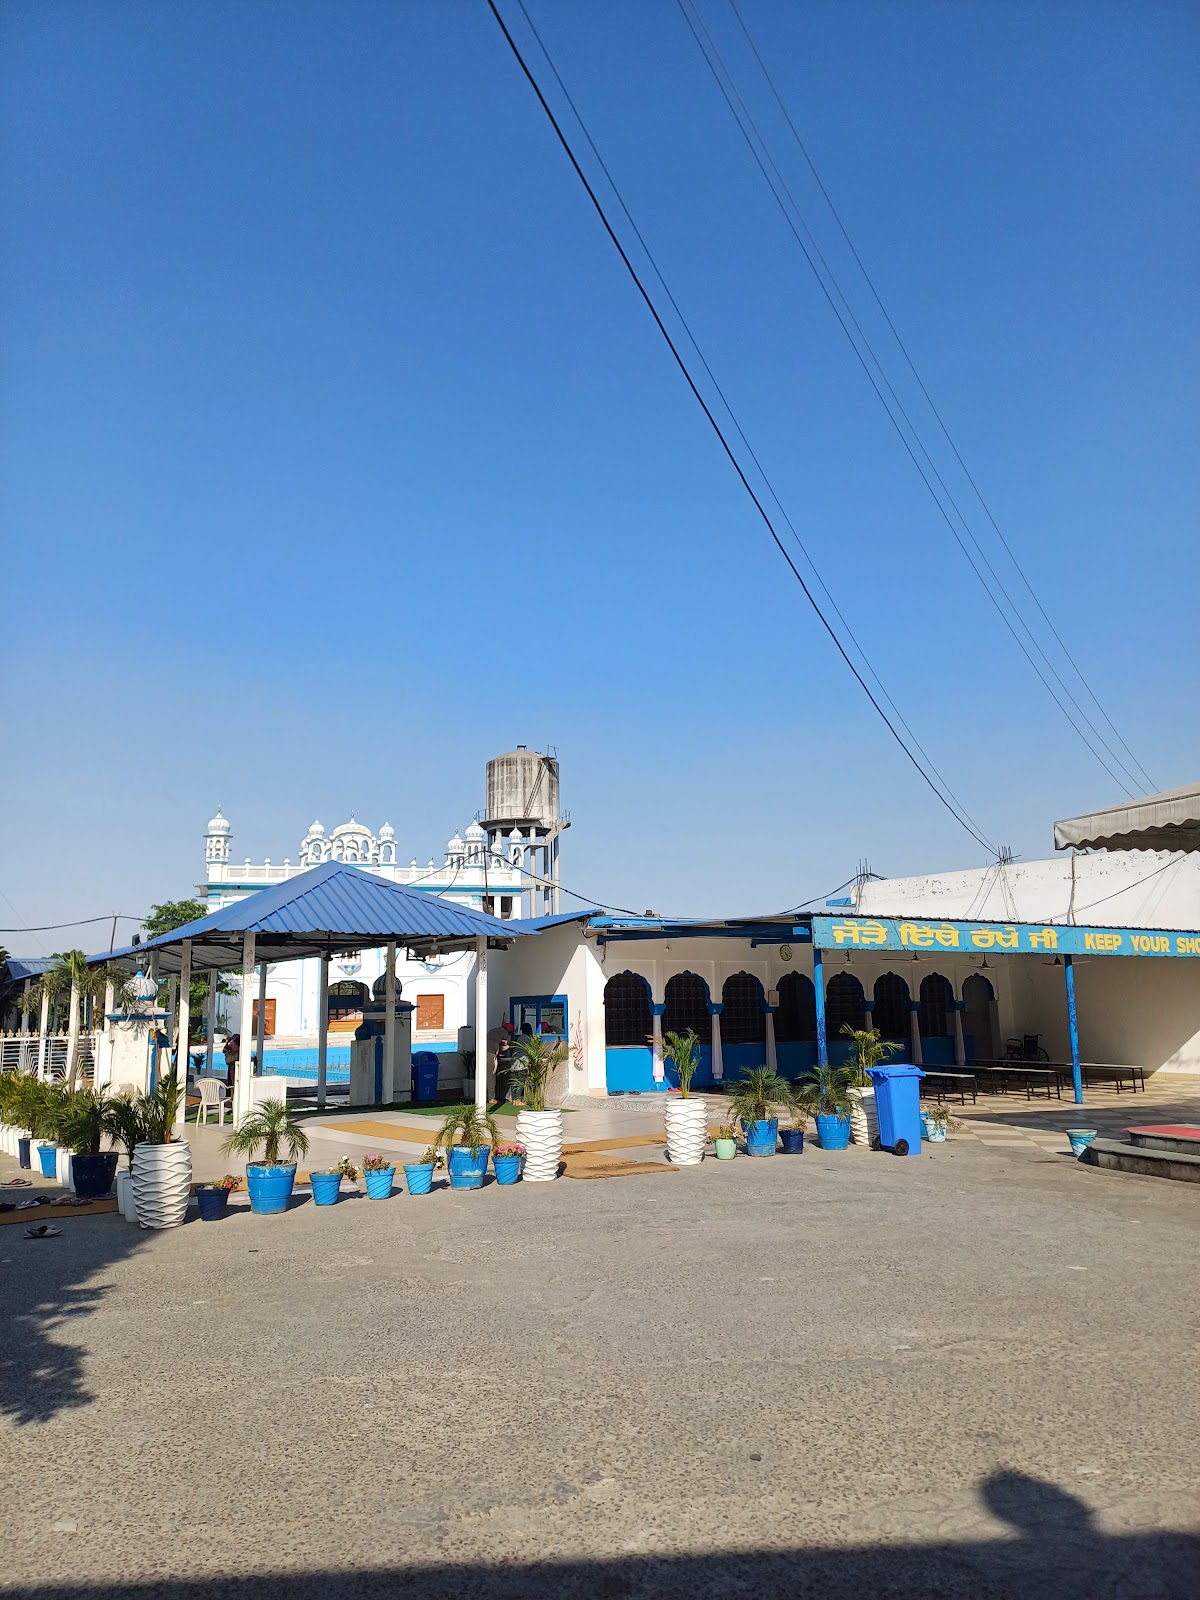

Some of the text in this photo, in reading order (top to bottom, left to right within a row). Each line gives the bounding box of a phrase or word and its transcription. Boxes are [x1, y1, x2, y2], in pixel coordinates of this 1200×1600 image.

[832, 919, 888, 945] ਜੋੜੇ
[1028, 928, 1058, 949] ਜੀ
[1084, 933, 1122, 951] KEEP
[1130, 935, 1170, 953] YOUR
